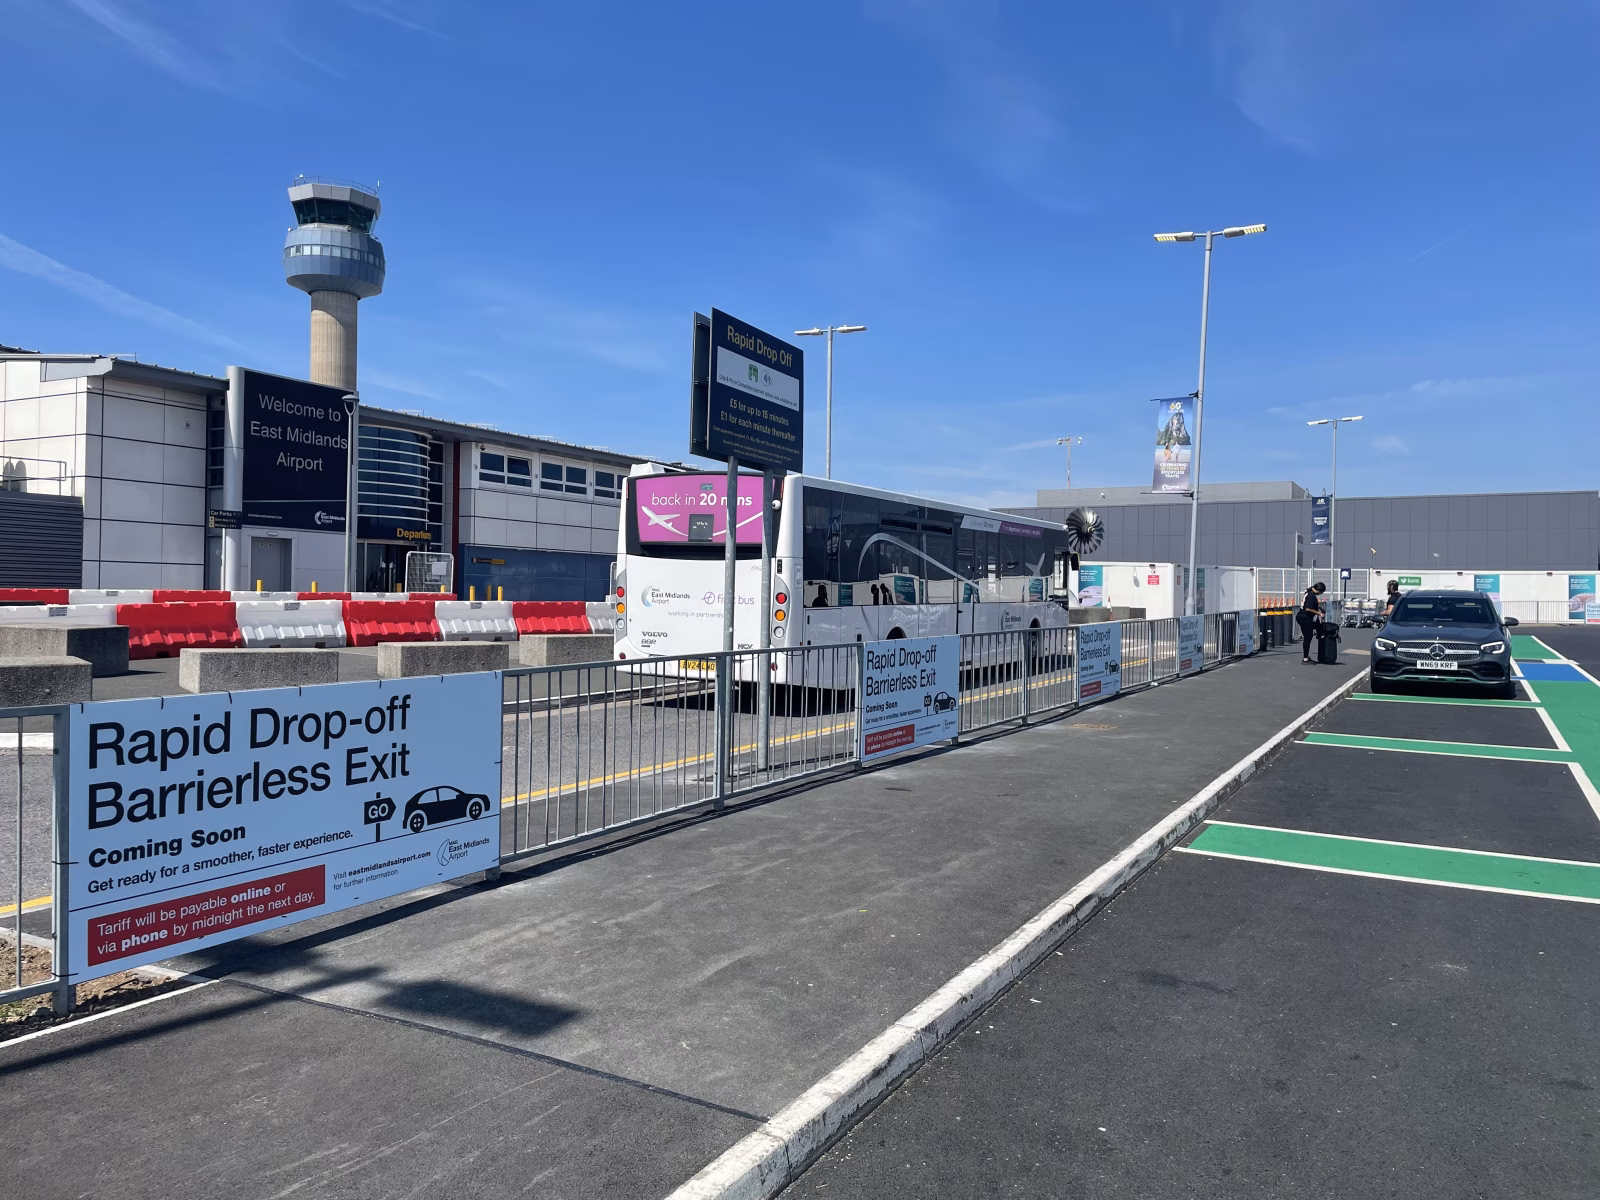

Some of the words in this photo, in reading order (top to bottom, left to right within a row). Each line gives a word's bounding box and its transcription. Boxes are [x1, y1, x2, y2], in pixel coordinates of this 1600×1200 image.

[728, 325, 754, 350] Rapid
[756, 339, 777, 363] Drop
[780, 350, 792, 367] Off
[259, 394, 324, 419] Welcome
[329, 408, 341, 421] to
[730, 398, 737, 408] £5
[747, 407, 755, 416] up
[755, 408, 761, 416] to
[762, 410, 768, 419] 15
[769, 412, 789, 426] minutes
[251, 420, 282, 439] East
[287, 427, 348, 449] Midlands
[721, 411, 728, 420] £1
[729, 413, 737, 424] for
[738, 418, 752, 429] each
[753, 422, 770, 434] minute
[771, 427, 796, 441] thereafter
[276, 452, 322, 471] Airport
[652, 492, 681, 505] back
[685, 494, 696, 505] in
[700, 493, 717, 506] 20
[738, 595, 754, 605] bus
[867, 648, 896, 673] Rapid
[899, 644, 936, 669] Drop-off
[866, 672, 917, 696] Barrierless
[920, 668, 936, 688] Exit
[866, 703, 884, 713] Coming
[886, 701, 898, 710] Soon
[89, 711, 231, 771] Rapid
[250, 694, 411, 750] Drop-off
[88, 762, 330, 830] Barrierless
[346, 742, 410, 786] Exit
[368, 803, 389, 819] GO
[89, 838, 182, 868] Coming
[191, 826, 246, 848] Soon
[449, 844, 462, 853] East
[464, 838, 490, 850] Midlands
[449, 850, 468, 860] Airport
[88, 878, 113, 893] Get
[118, 870, 157, 884] ready
[160, 866, 179, 878] for
[182, 864, 190, 874] a
[193, 850, 255, 871] smoother,
[258, 842, 291, 857] faster
[293, 830, 353, 849] experience.
[333, 872, 347, 880] Visit
[348, 851, 431, 876] eastmidlandsairport.com
[333, 882, 342, 890] for
[343, 877, 364, 888] further
[97, 917, 131, 936] Tariff
[135, 912, 155, 927] will
[160, 910, 176, 921] be
[180, 896, 227, 919] payable
[231, 886, 271, 903] online
[274, 882, 286, 893] or
[98, 941, 116, 955] via
[122, 929, 168, 951] phone
[173, 923, 188, 936] by
[192, 908, 243, 930] midnight
[247, 904, 264, 916] the
[268, 896, 291, 910] next
[294, 892, 315, 904] day.
